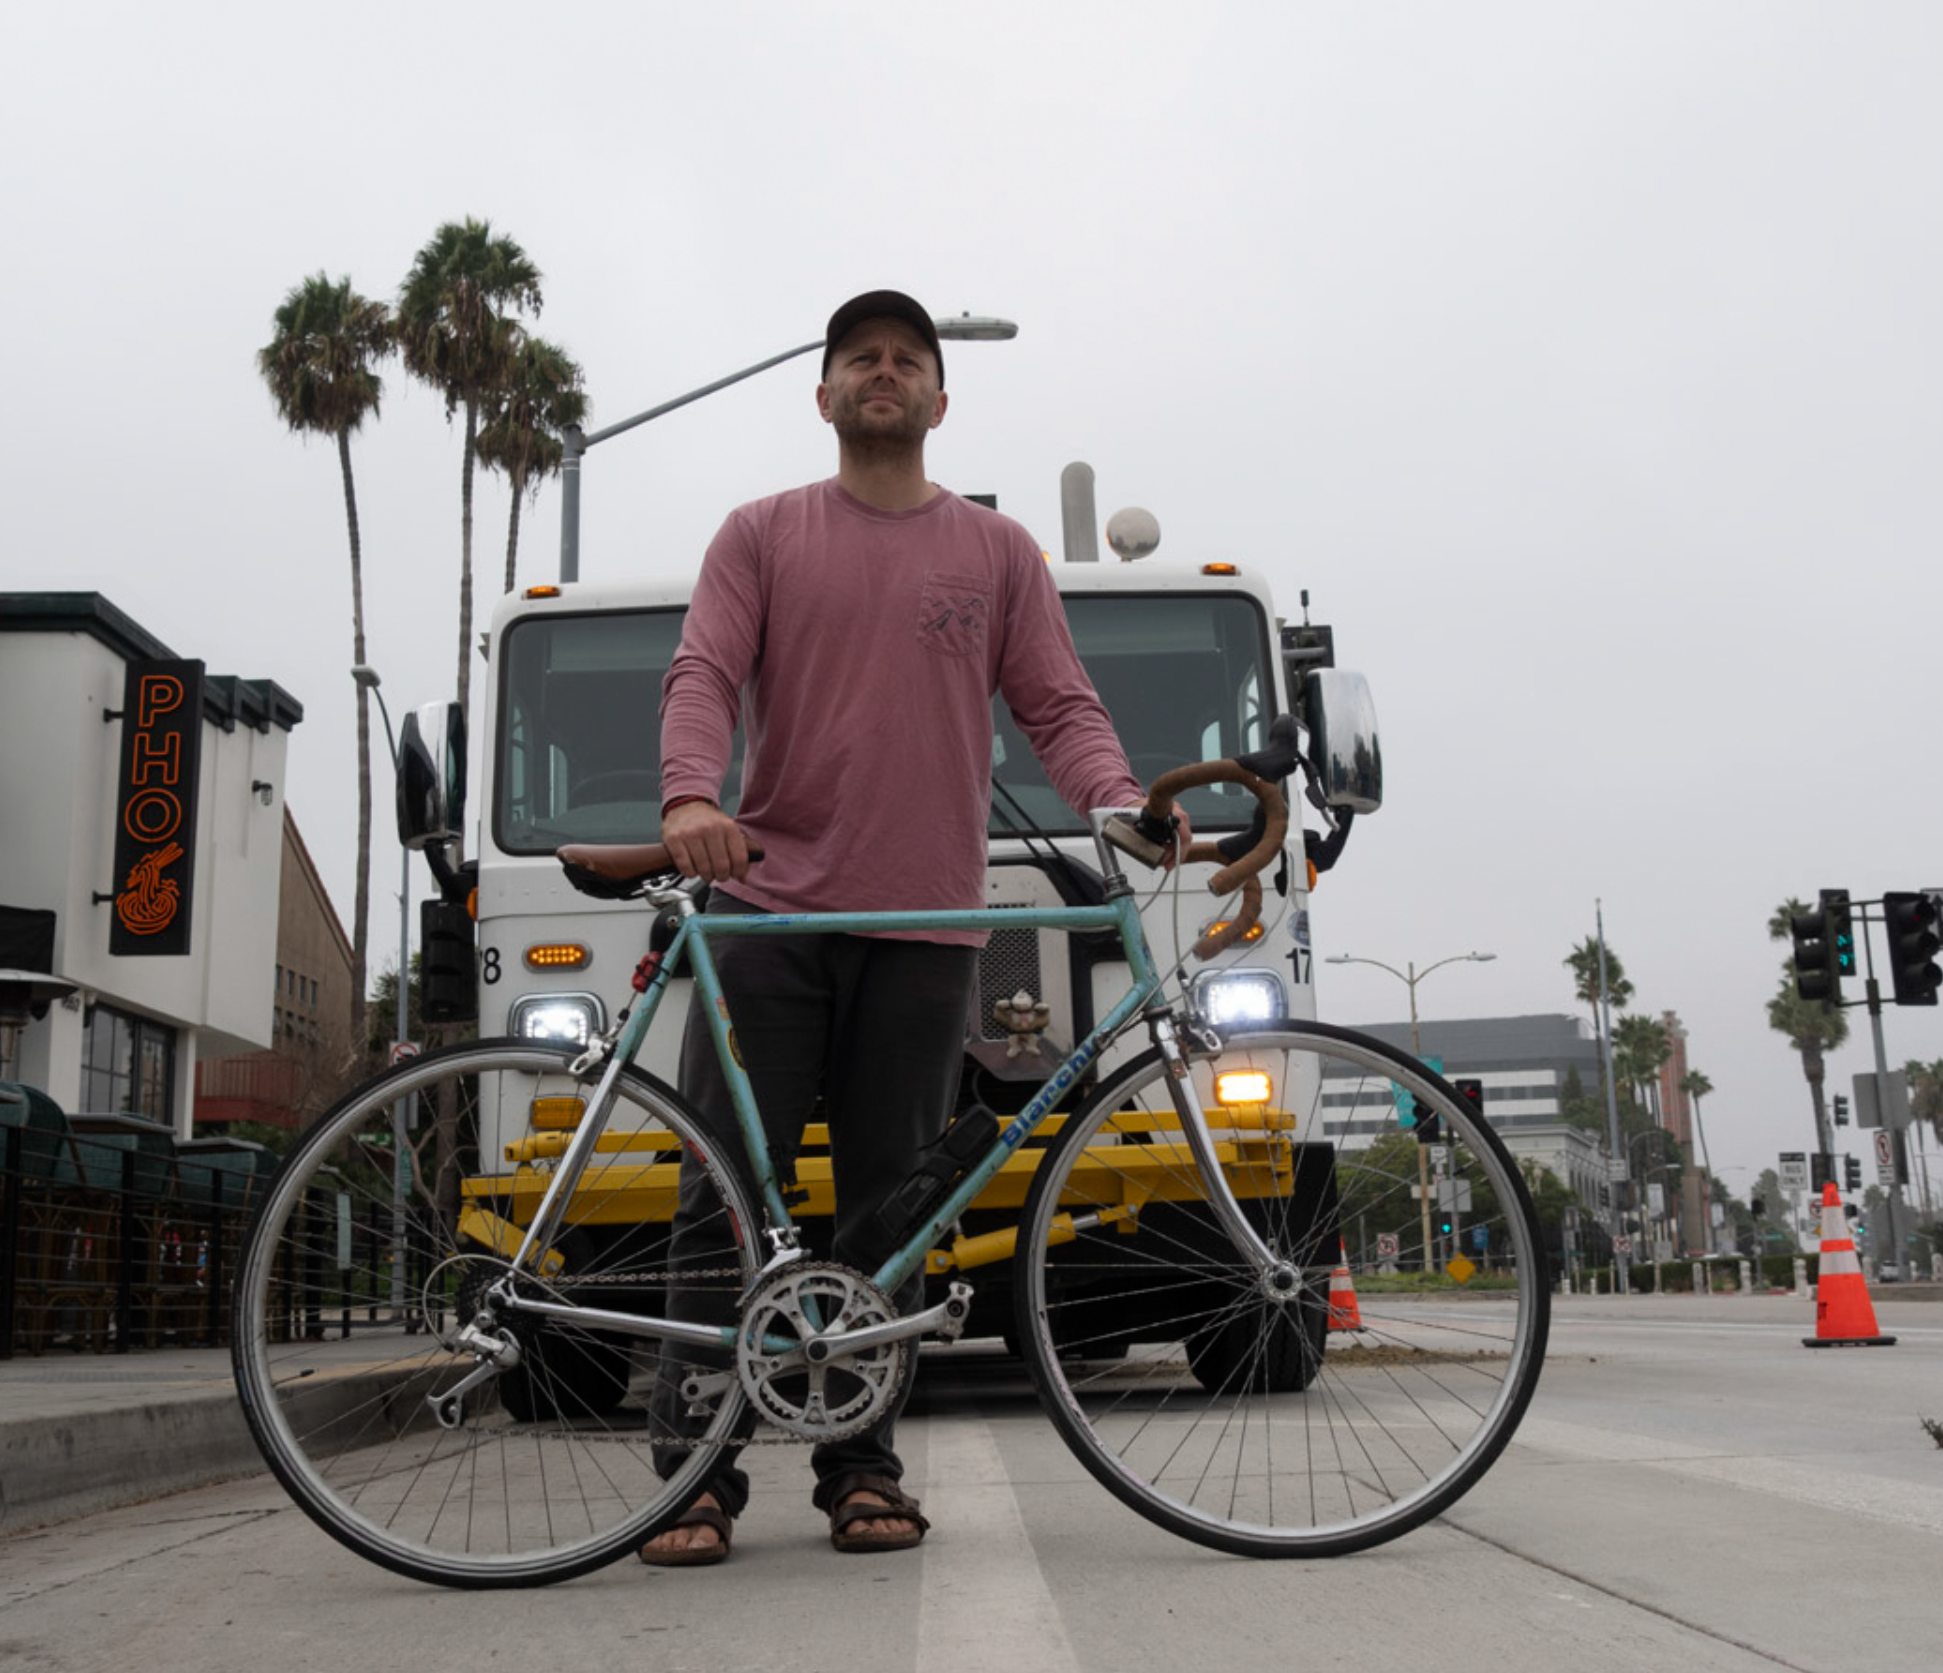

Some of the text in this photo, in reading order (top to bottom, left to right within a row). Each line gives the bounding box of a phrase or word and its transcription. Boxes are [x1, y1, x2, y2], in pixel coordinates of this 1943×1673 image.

[124, 675, 184, 843] PHO
[479, 947, 502, 985] 8
[1285, 947, 1311, 985] 17
[1782, 1176, 1805, 1185] ONLY
